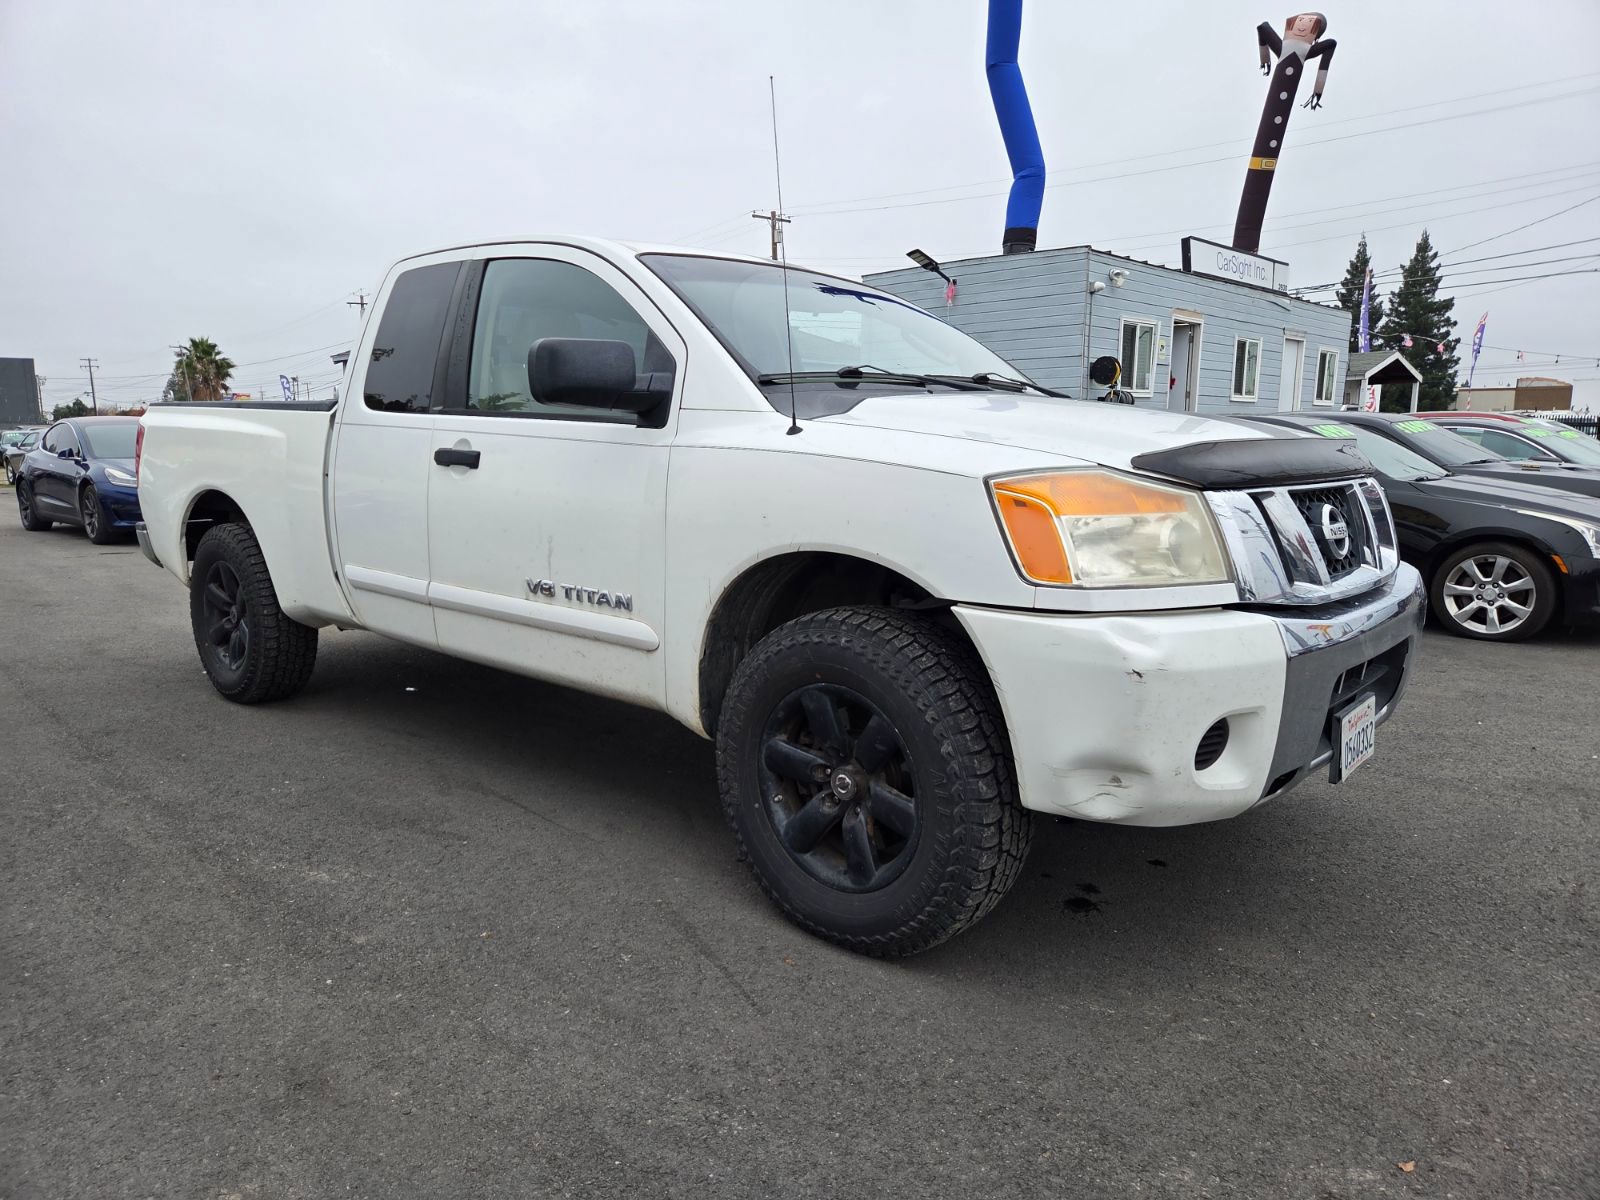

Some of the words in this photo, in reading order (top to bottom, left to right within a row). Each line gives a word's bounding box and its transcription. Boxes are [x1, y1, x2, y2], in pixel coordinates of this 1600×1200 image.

[1216, 251, 1252, 279] CarSight
[1253, 261, 1268, 281] Inc.
[525, 577, 556, 598] V8
[560, 583, 633, 612] TITAN
